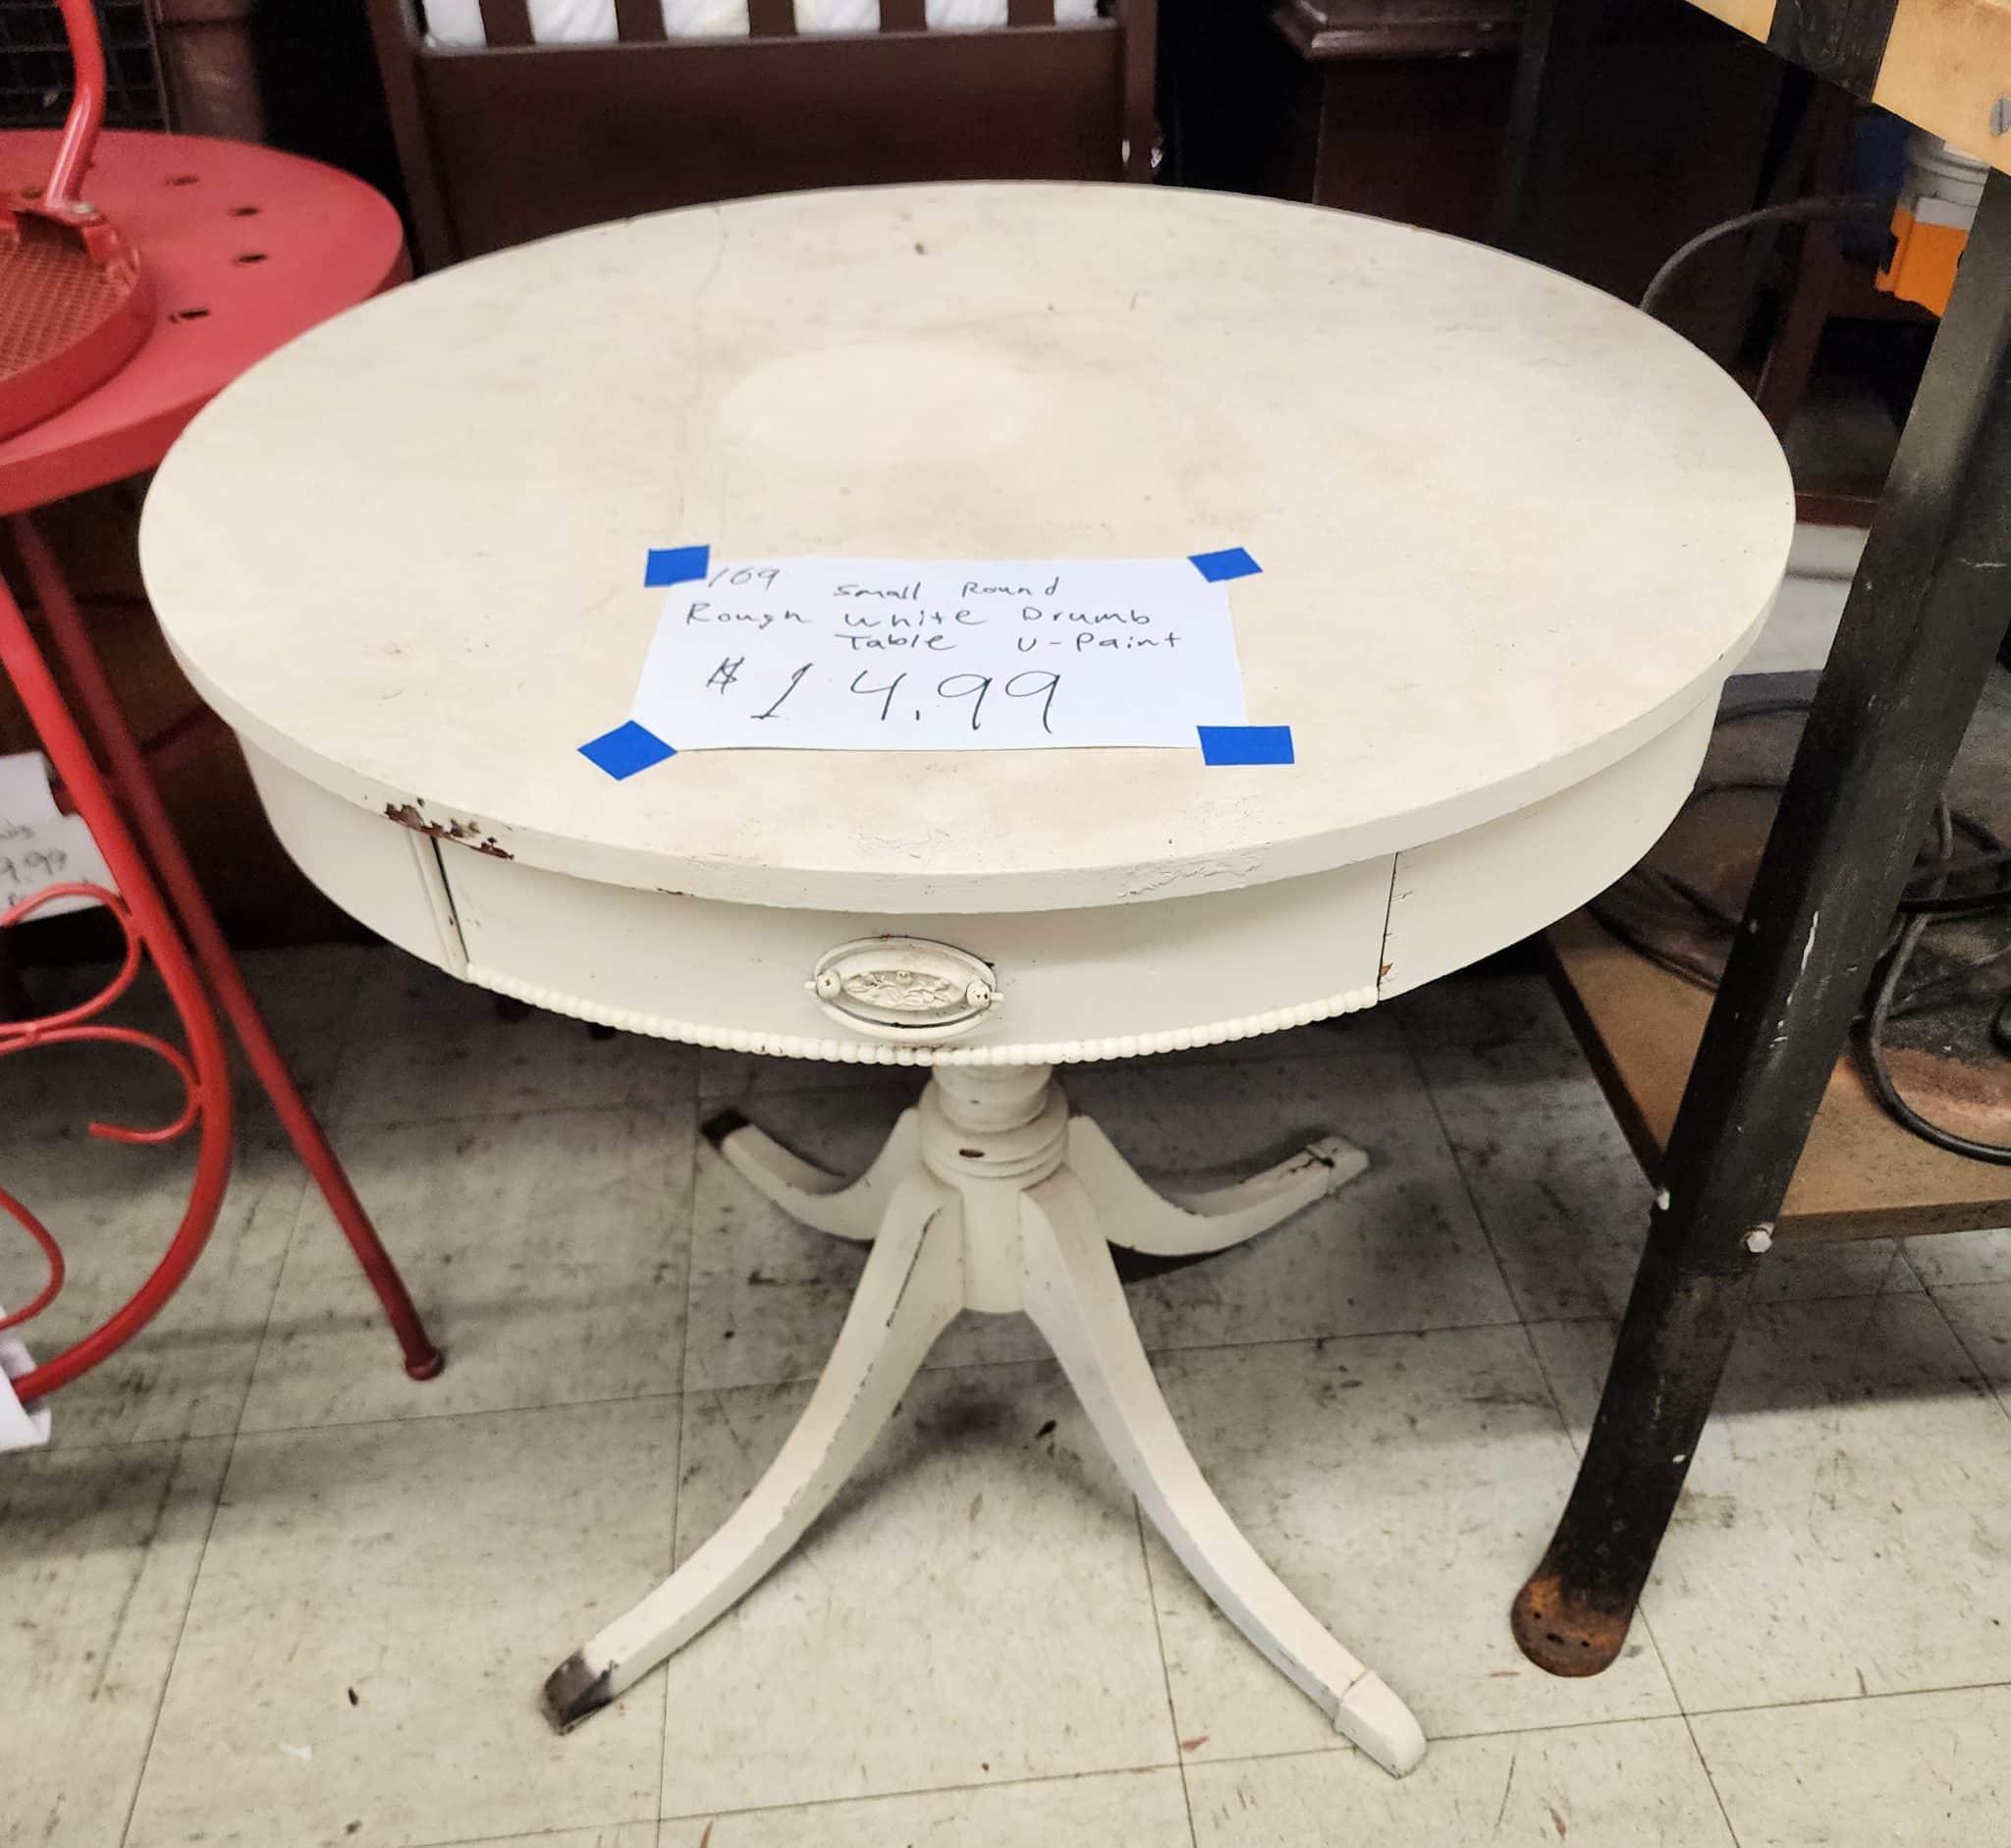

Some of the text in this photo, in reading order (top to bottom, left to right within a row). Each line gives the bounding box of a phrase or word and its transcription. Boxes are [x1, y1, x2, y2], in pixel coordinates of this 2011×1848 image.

[961, 575, 1060, 598] Round
[685, 602, 812, 629] Rough
[1021, 606, 1152, 625] Drumb
[834, 632, 957, 651] Table
